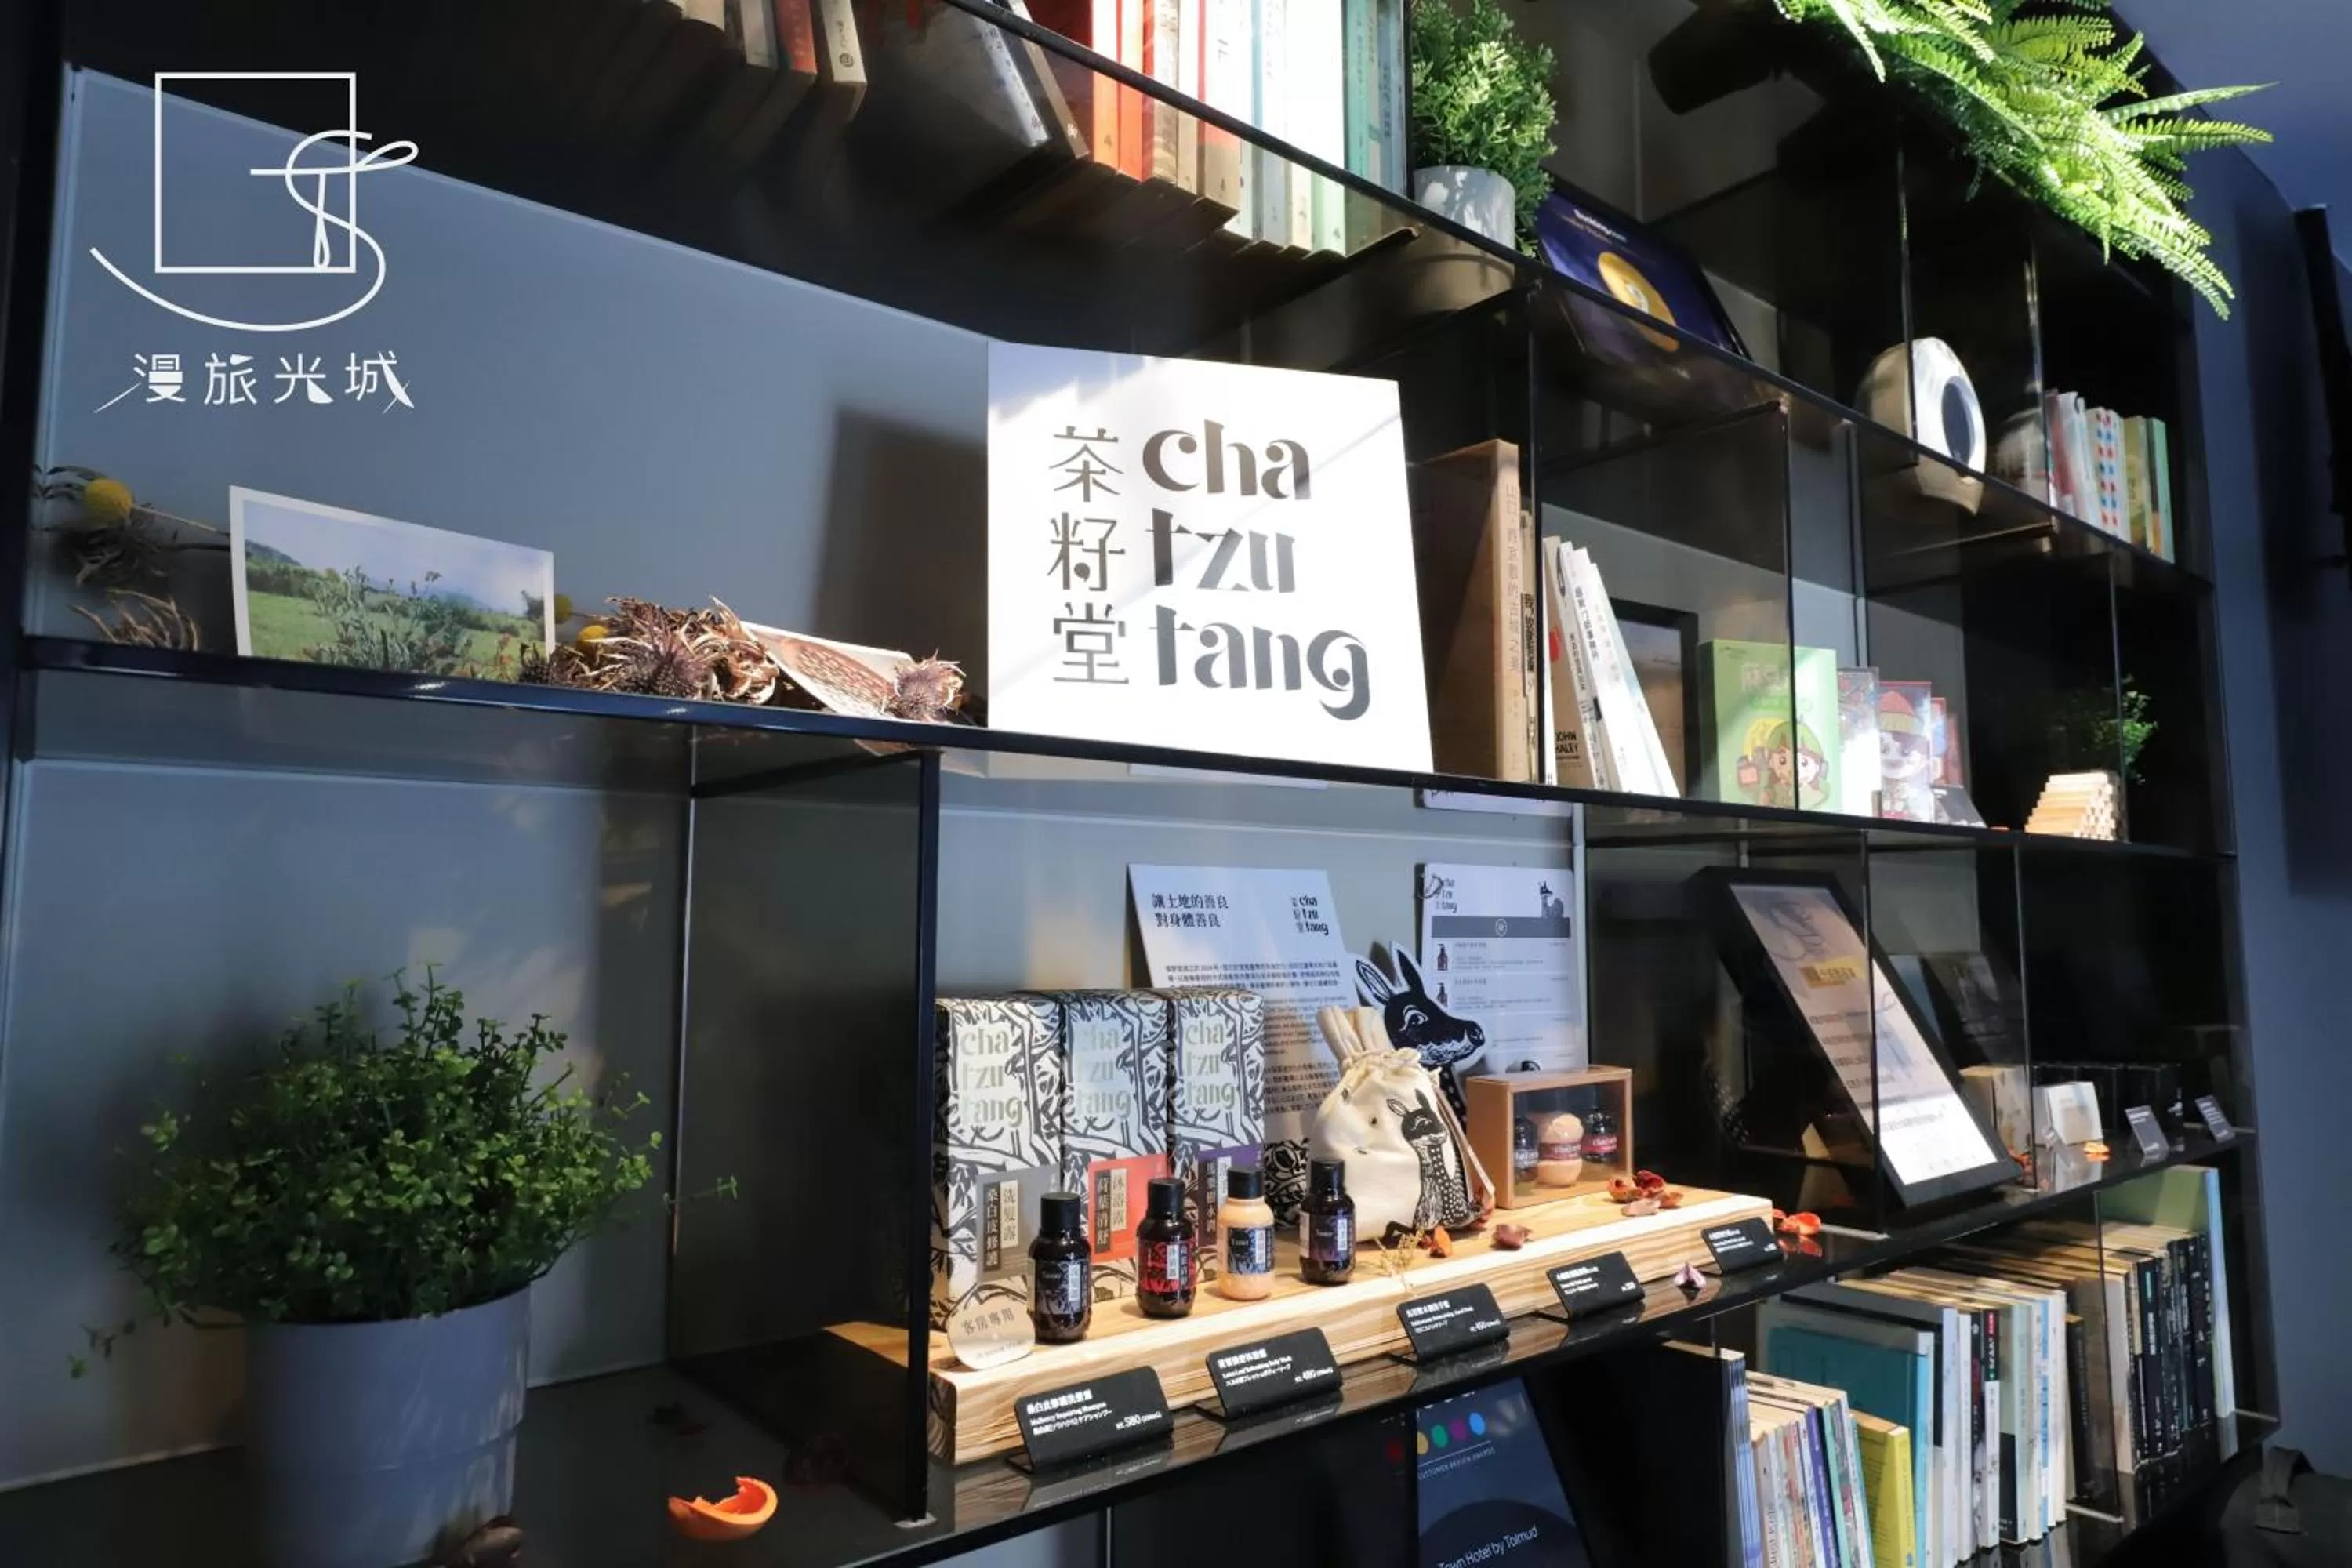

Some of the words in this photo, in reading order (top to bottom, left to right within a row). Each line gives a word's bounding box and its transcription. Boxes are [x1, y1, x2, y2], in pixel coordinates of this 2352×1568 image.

[1142, 419, 1311, 500] cha
[1047, 425, 1129, 685] 茶籽堂
[1145, 507, 1294, 593] tzu
[1149, 604, 1371, 720] tang
[1152, 892, 1229, 909] 讓土地的善良
[1155, 912, 1221, 928] 對身體善良
[960, 1028, 1009, 1055] cha
[1185, 1018, 1224, 1044] cha
